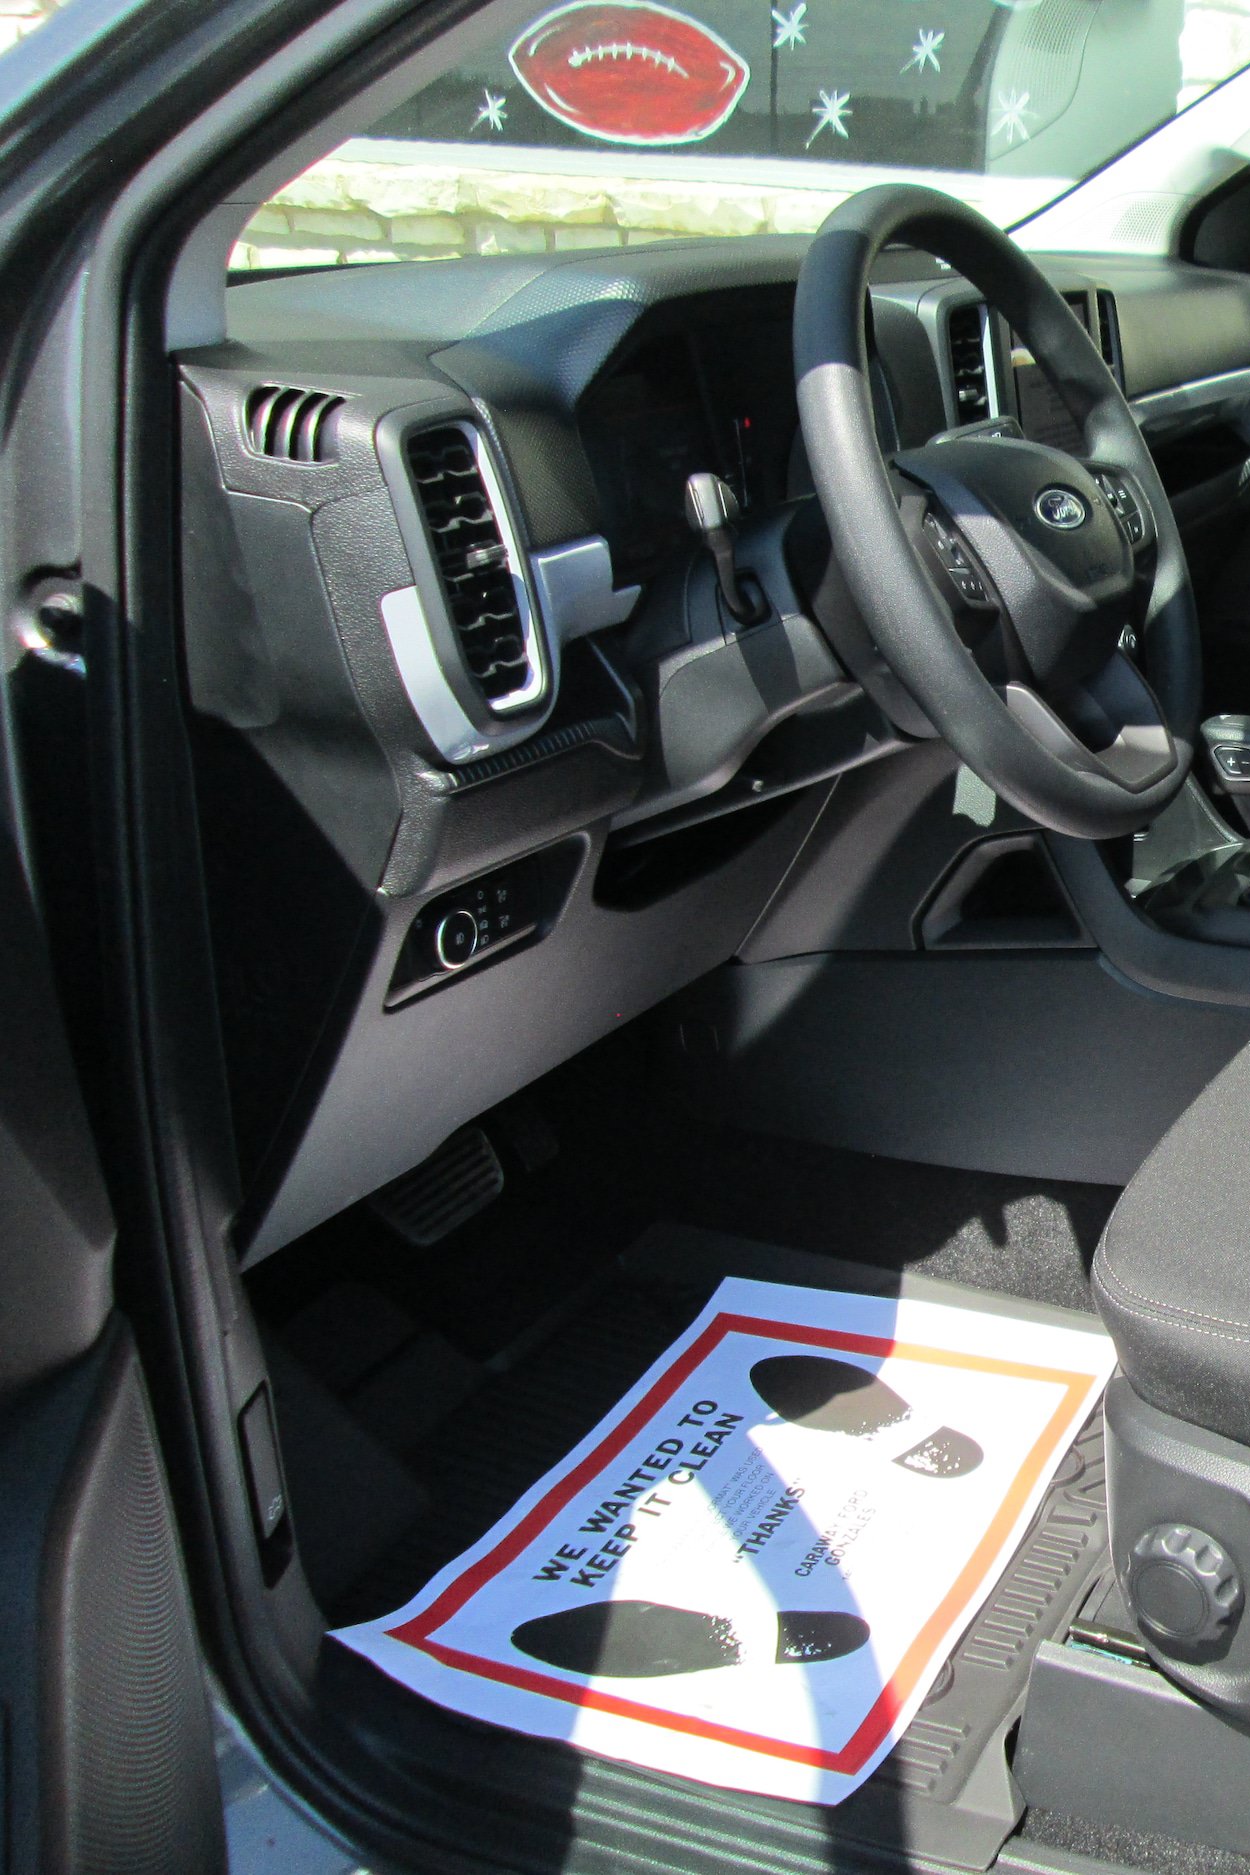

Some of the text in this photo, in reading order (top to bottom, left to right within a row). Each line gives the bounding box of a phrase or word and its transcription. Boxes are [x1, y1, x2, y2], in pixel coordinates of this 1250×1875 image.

[532, 1543, 588, 1581] WE
[578, 1438, 685, 1533] WANTED
[677, 1400, 719, 1427] TO
[570, 1523, 638, 1587] KEEP
[638, 1492, 672, 1517] IT
[668, 1413, 745, 1485] CLEAN
[824, 1507, 876, 1566] GONZALES
[794, 1523, 839, 1577] CARAWAY
